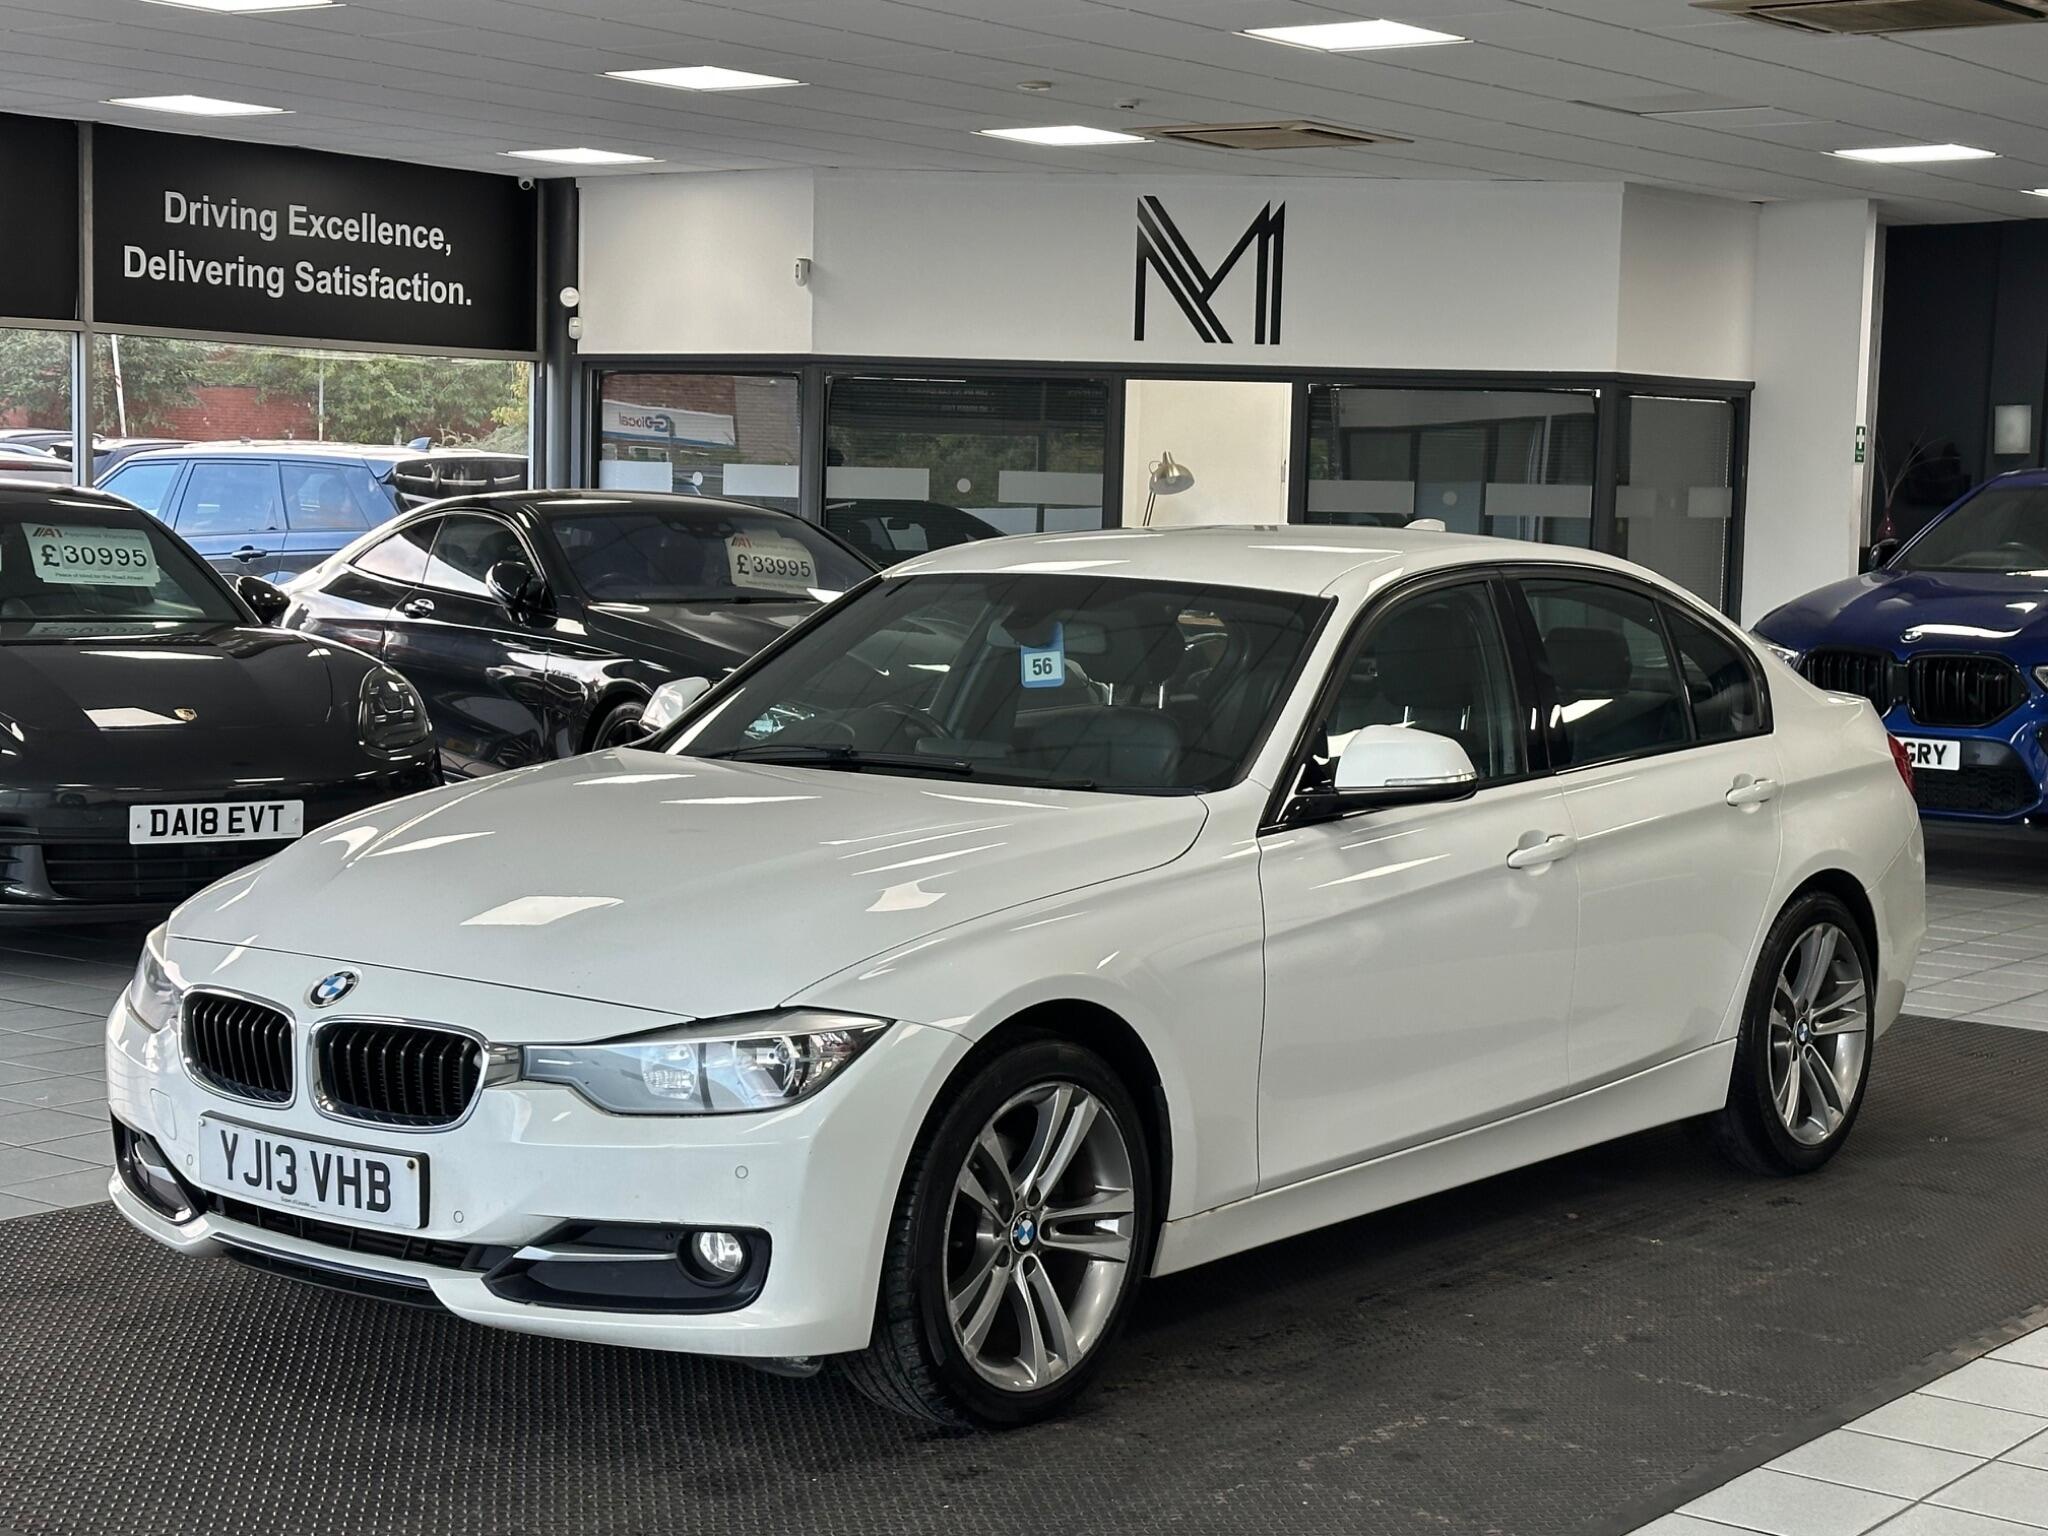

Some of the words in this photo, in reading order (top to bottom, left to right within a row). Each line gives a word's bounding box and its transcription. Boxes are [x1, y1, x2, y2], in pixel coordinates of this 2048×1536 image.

[165, 191, 277, 241] Driving
[288, 204, 452, 256] Excellence,
[124, 245, 284, 298] Delivering
[295, 261, 472, 306] Satisfaction.
[41, 544, 147, 567] £30995
[737, 554, 811, 577] £33995
[1032, 657, 1053, 676] 56
[150, 807, 218, 837] DA18
[228, 805, 284, 833] EVT
[220, 1130, 298, 1196] YJ13
[309, 1150, 392, 1213] VHB
